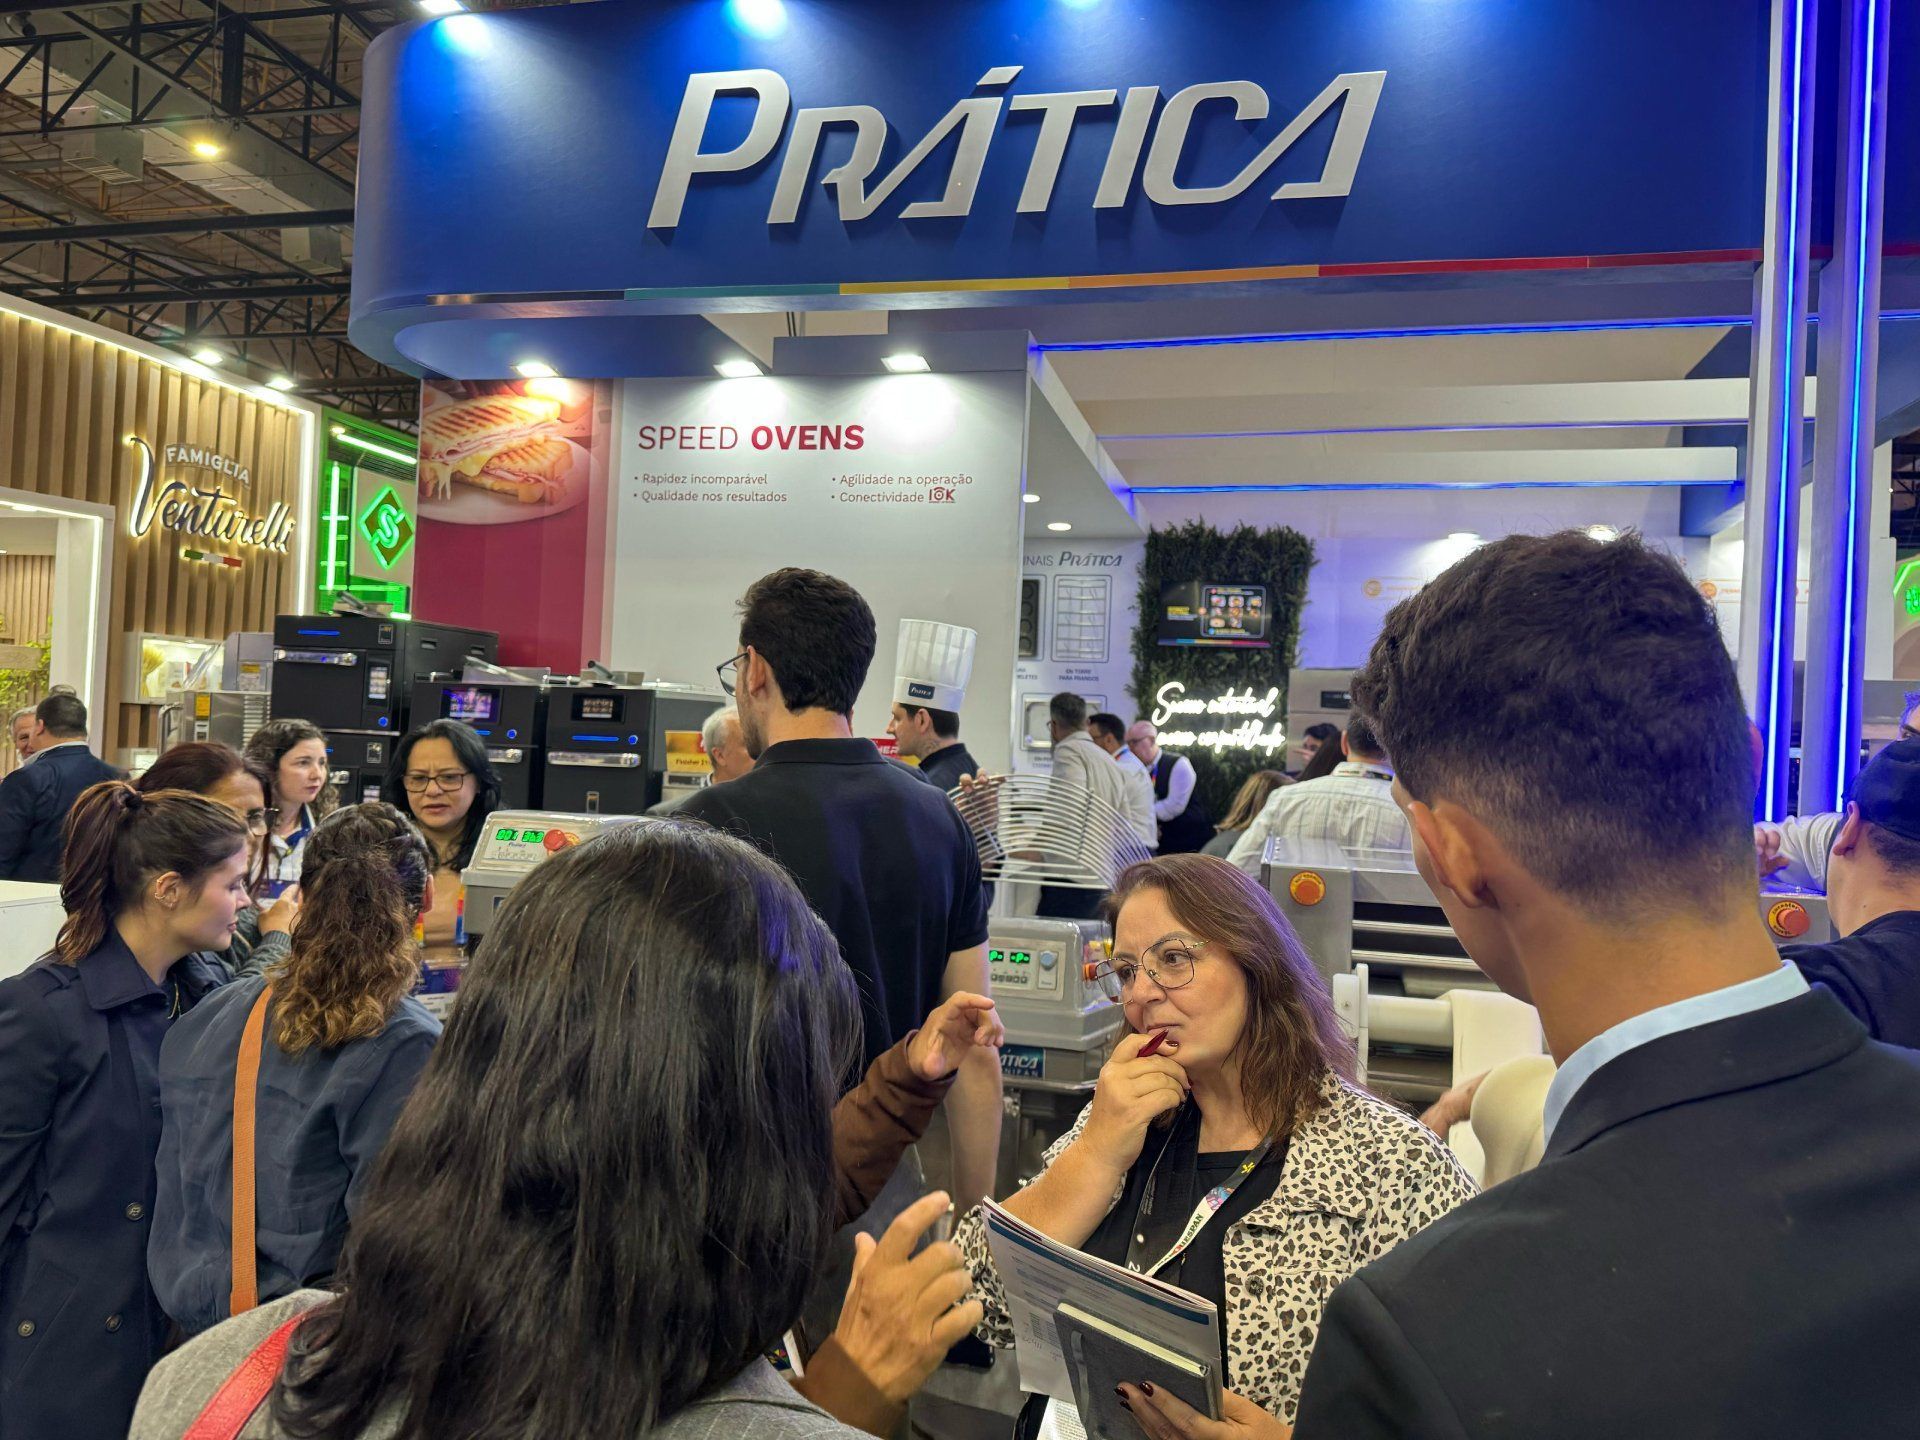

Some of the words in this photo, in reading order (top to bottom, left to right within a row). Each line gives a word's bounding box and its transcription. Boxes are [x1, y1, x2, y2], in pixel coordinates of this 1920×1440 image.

[647, 65, 1387, 228] PRÁTICA
[638, 425, 739, 450] SPEED
[751, 424, 865, 450] OVENS
[166, 446, 250, 484] FAMIGLIA
[643, 473, 687, 487] Rapidez
[691, 473, 768, 487] incomparável
[840, 474, 894, 487] Agilidade
[898, 476, 912, 485] na
[916, 474, 973, 487] operação
[127, 436, 297, 554] Venturelli
[642, 490, 698, 503] Qualidade
[702, 492, 723, 502] nos
[726, 490, 787, 502] resultados
[840, 492, 924, 503] Conectividade
